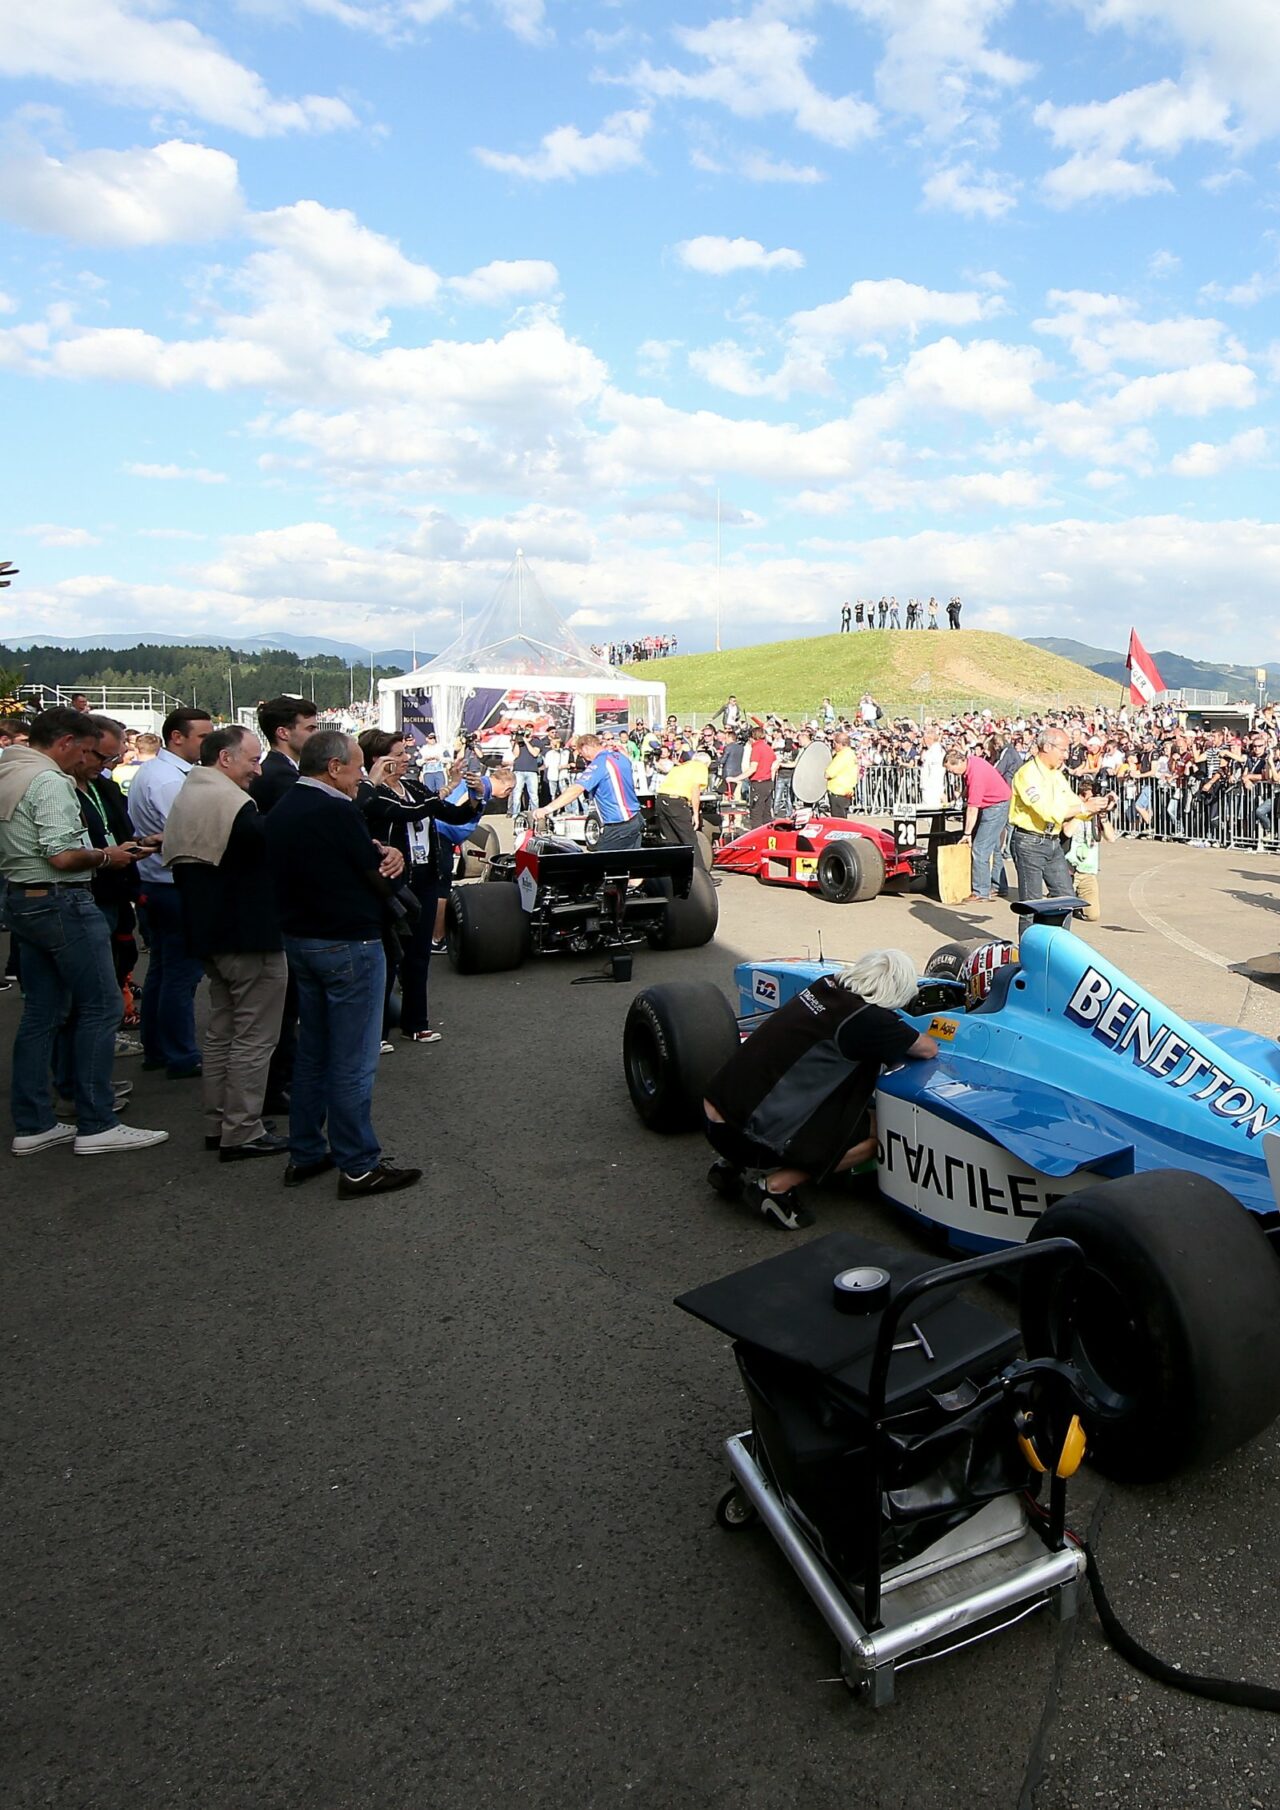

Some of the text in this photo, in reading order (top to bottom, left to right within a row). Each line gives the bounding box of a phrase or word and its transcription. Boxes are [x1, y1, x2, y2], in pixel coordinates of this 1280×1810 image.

[898, 823, 915, 845] 28
[756, 979, 776, 1000] D2
[940, 1022, 956, 1035] Agip
